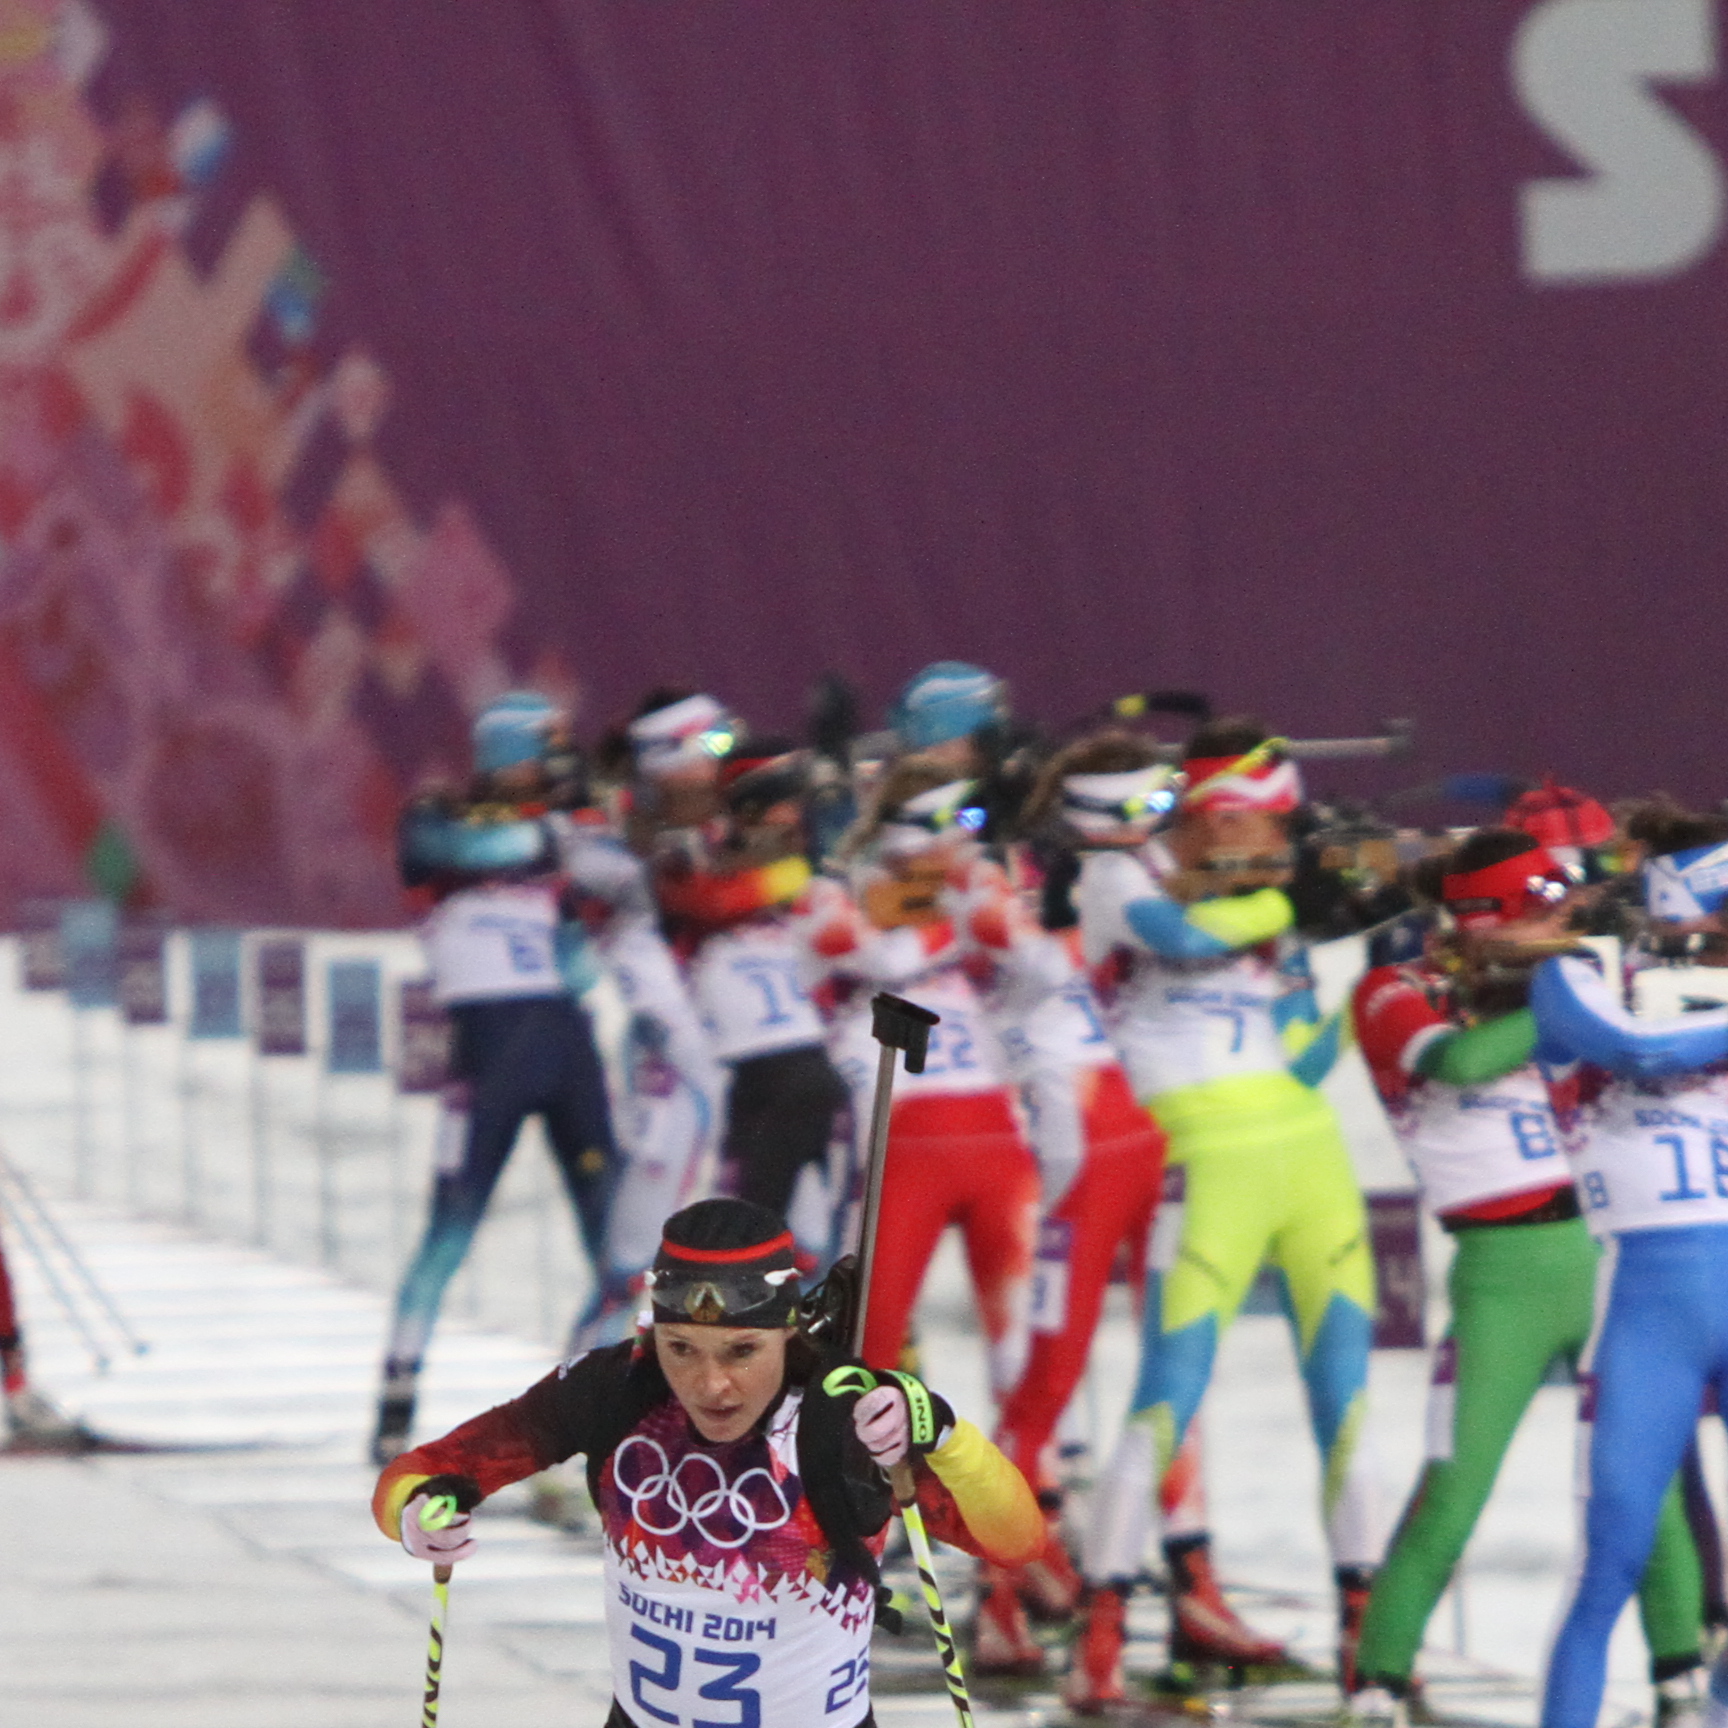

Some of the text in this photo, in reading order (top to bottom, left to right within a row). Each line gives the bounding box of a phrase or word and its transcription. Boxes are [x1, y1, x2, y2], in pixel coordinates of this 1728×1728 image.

[1202, 1007, 1246, 1053] 7
[618, 1580, 777, 1642] SOCHI 2014
